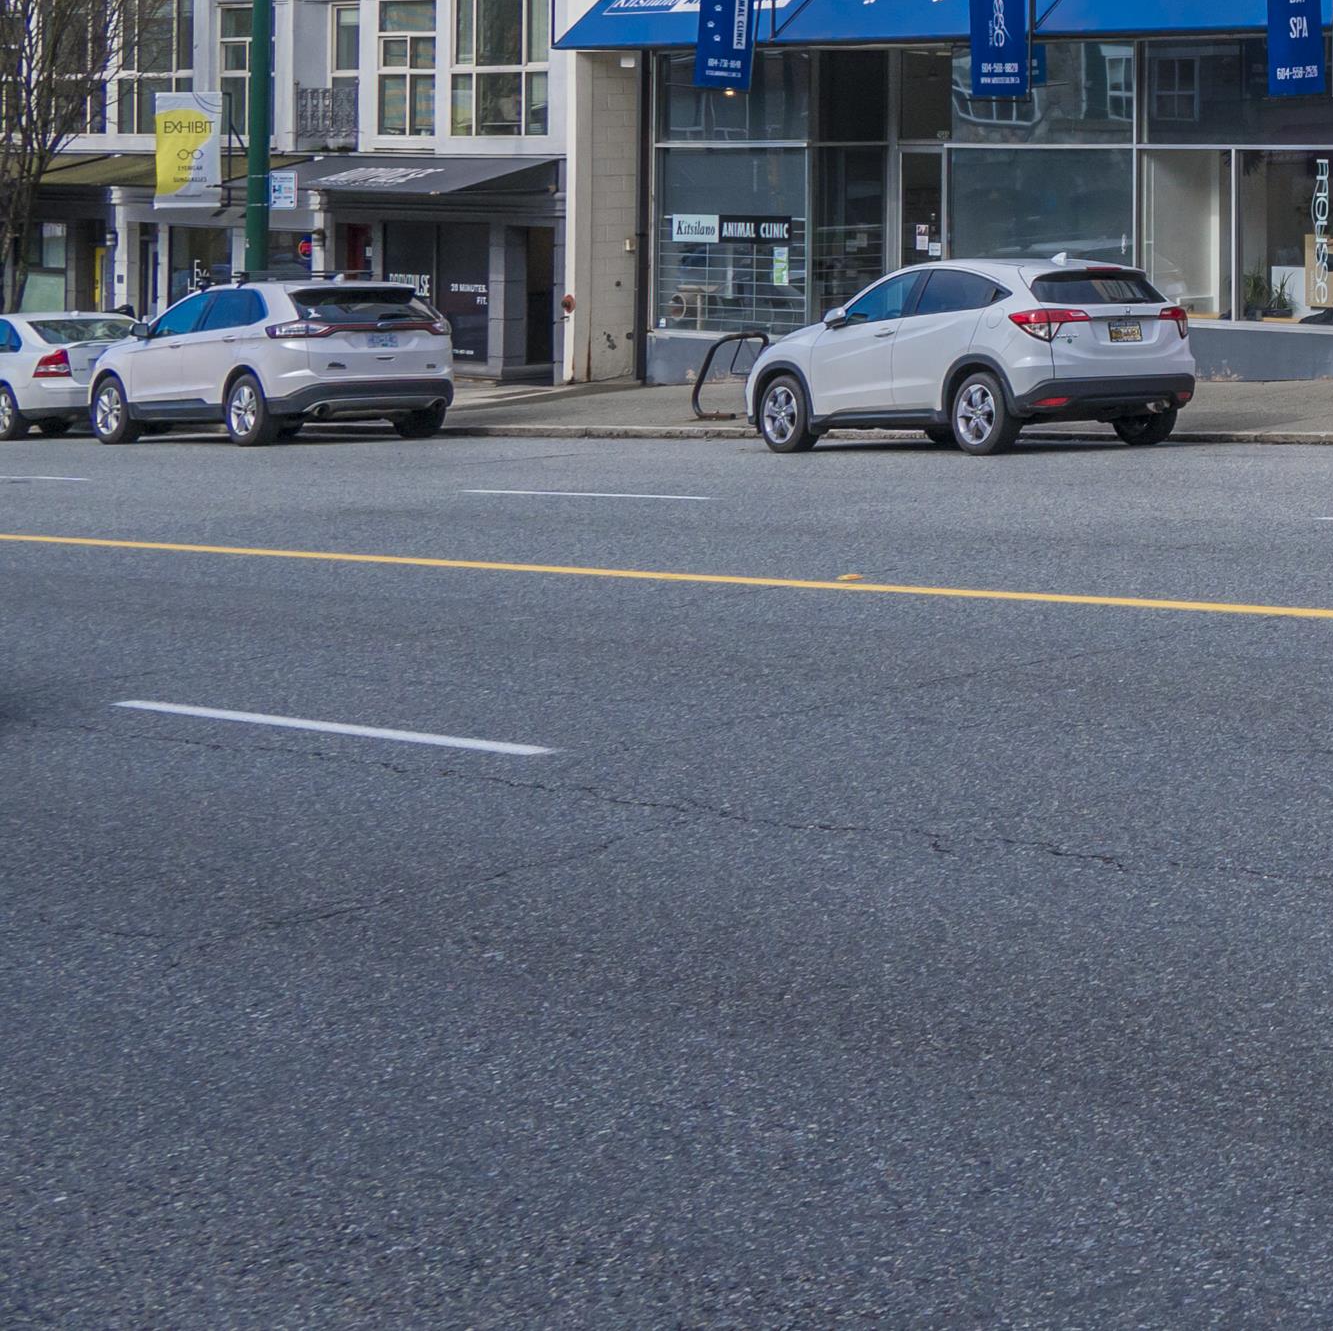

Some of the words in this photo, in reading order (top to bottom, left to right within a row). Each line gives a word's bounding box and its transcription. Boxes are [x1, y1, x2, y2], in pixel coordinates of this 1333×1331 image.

[735, 19, 746, 47] CLINIC
[1290, 16, 1308, 38] SPA
[164, 121, 215, 134] EXHIBIT
[676, 221, 715, 236] Kitsilano
[722, 222, 756, 237] ANIMAL
[760, 223, 789, 238] CLINIC
